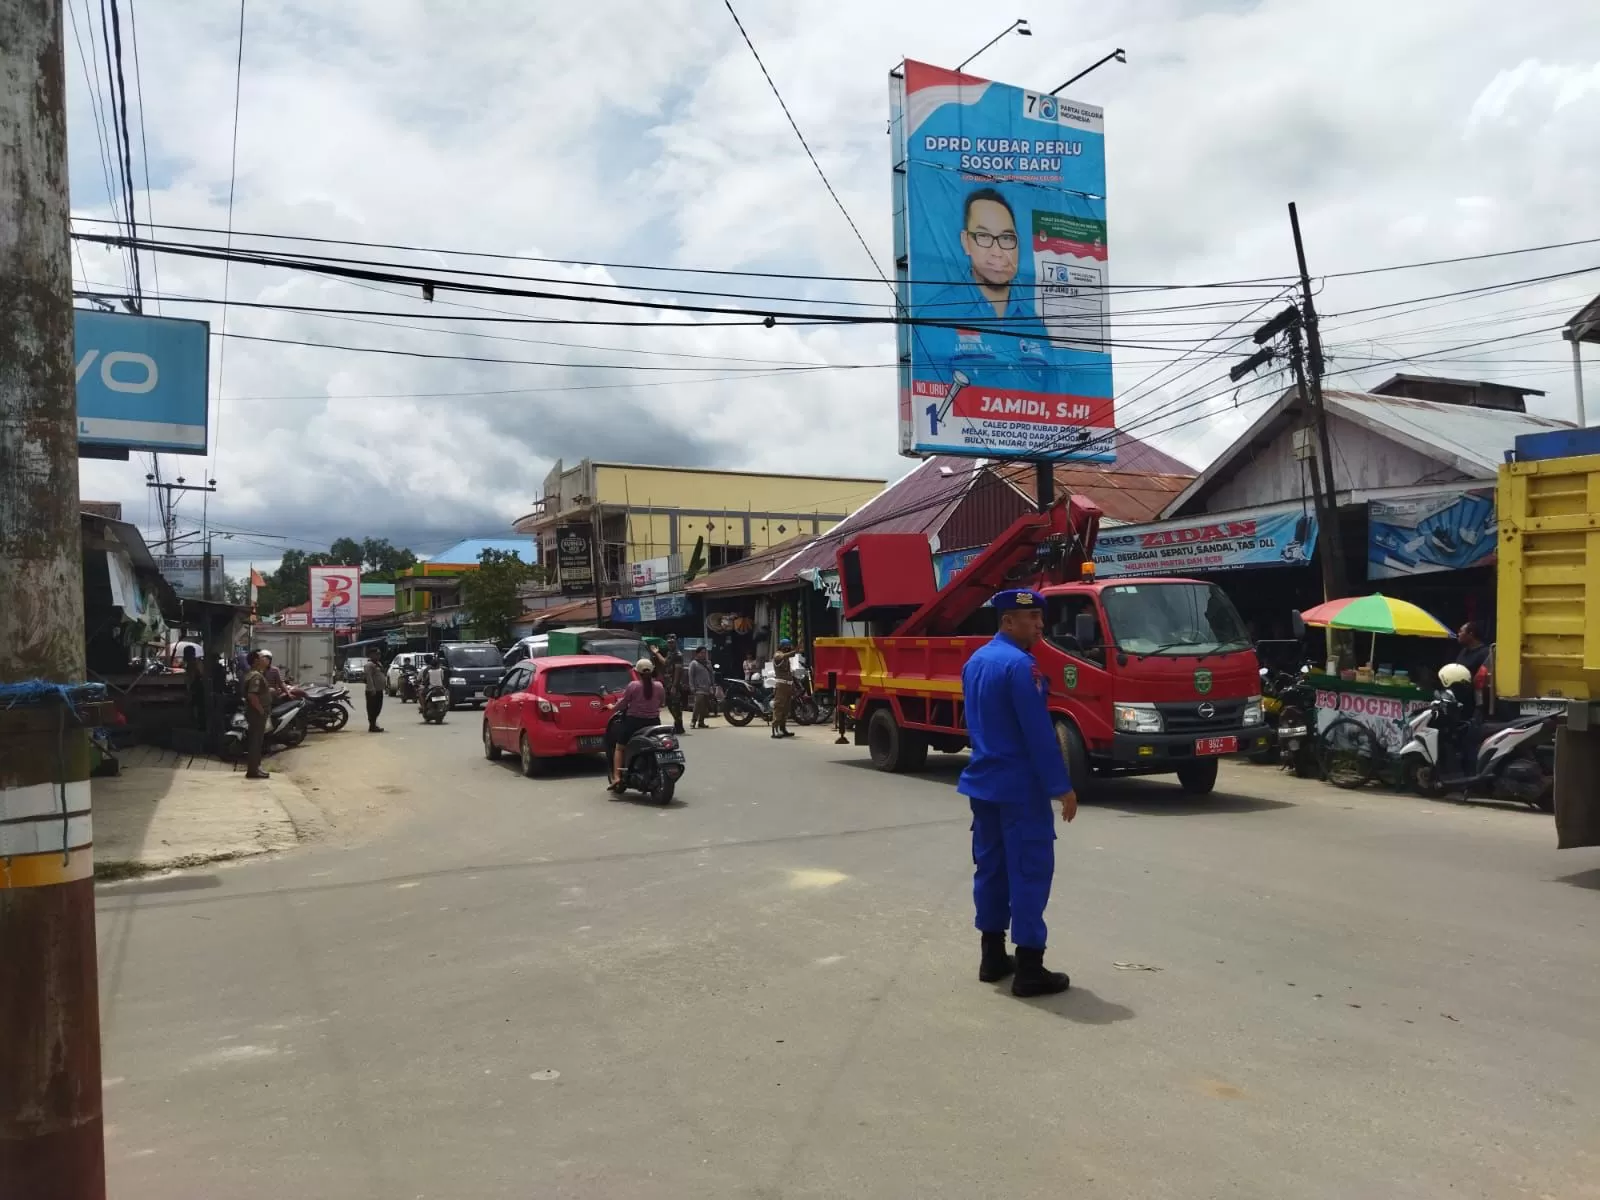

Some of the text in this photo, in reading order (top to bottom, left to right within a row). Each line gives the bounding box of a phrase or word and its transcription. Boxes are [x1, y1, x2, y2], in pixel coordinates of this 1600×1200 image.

[1027, 95, 1037, 113] 7
[925, 136, 1082, 155] DPRD KUBAR PERLU
[961, 155, 1061, 171] SOSOK BARU
[926, 403, 938, 435] 1
[980, 396, 1050, 419] JAMIDI,
[982, 420, 1008, 429] CALEG
[1009, 421, 1031, 431] DPRD
[1032, 424, 1058, 433] KUBAR
[1141, 520, 1257, 548] ZIDAN
[1117, 551, 1158, 562] BERBAGAI
[1260, 538, 1275, 548] DLL
[1315, 689, 1403, 720] ES DOGER
